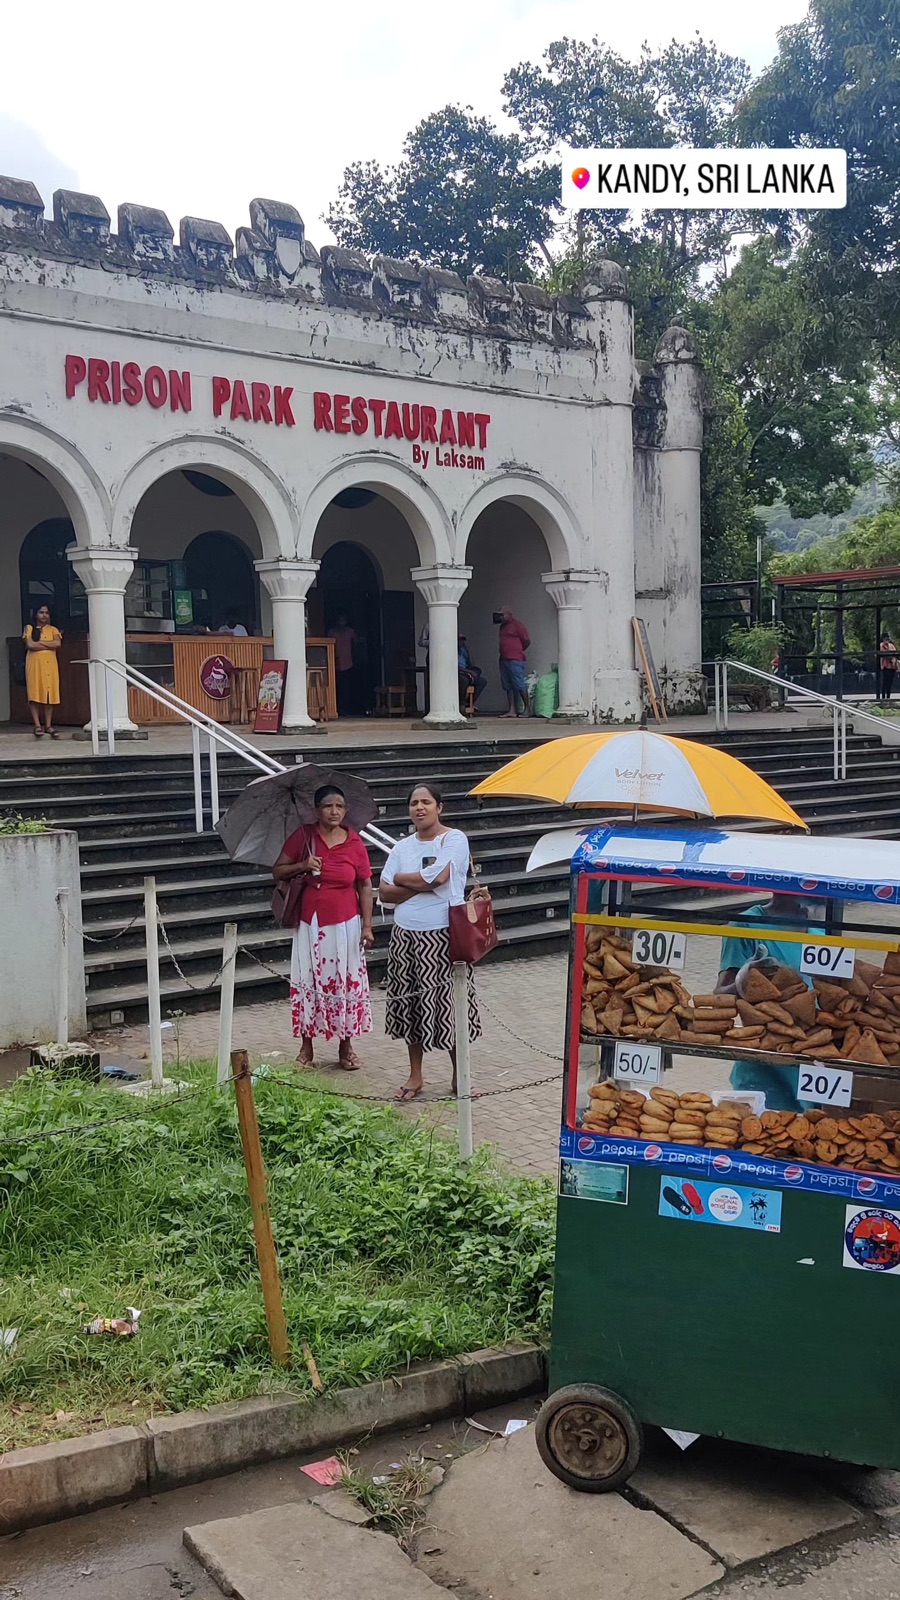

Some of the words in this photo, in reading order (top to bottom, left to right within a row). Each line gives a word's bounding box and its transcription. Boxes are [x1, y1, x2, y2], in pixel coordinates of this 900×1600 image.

[65, 354, 192, 412] PRISON
[212, 376, 296, 426] PARK
[313, 391, 491, 450] RESTAURANT
[412, 444, 429, 469] By
[436, 446, 485, 471] Laksam
[614, 767, 665, 781] Velvet
[826, 881, 866, 892] pepsi
[636, 930, 681, 965] 30/-
[803, 946, 852, 971] 60/-
[619, 1052, 656, 1075] 50/-
[800, 1073, 849, 1099] 20/-
[601, 1143, 636, 1157] pepsi
[668, 1152, 706, 1165] pepsi
[738, 1162, 777, 1176] pepsi
[810, 1174, 849, 1188] pepsi
